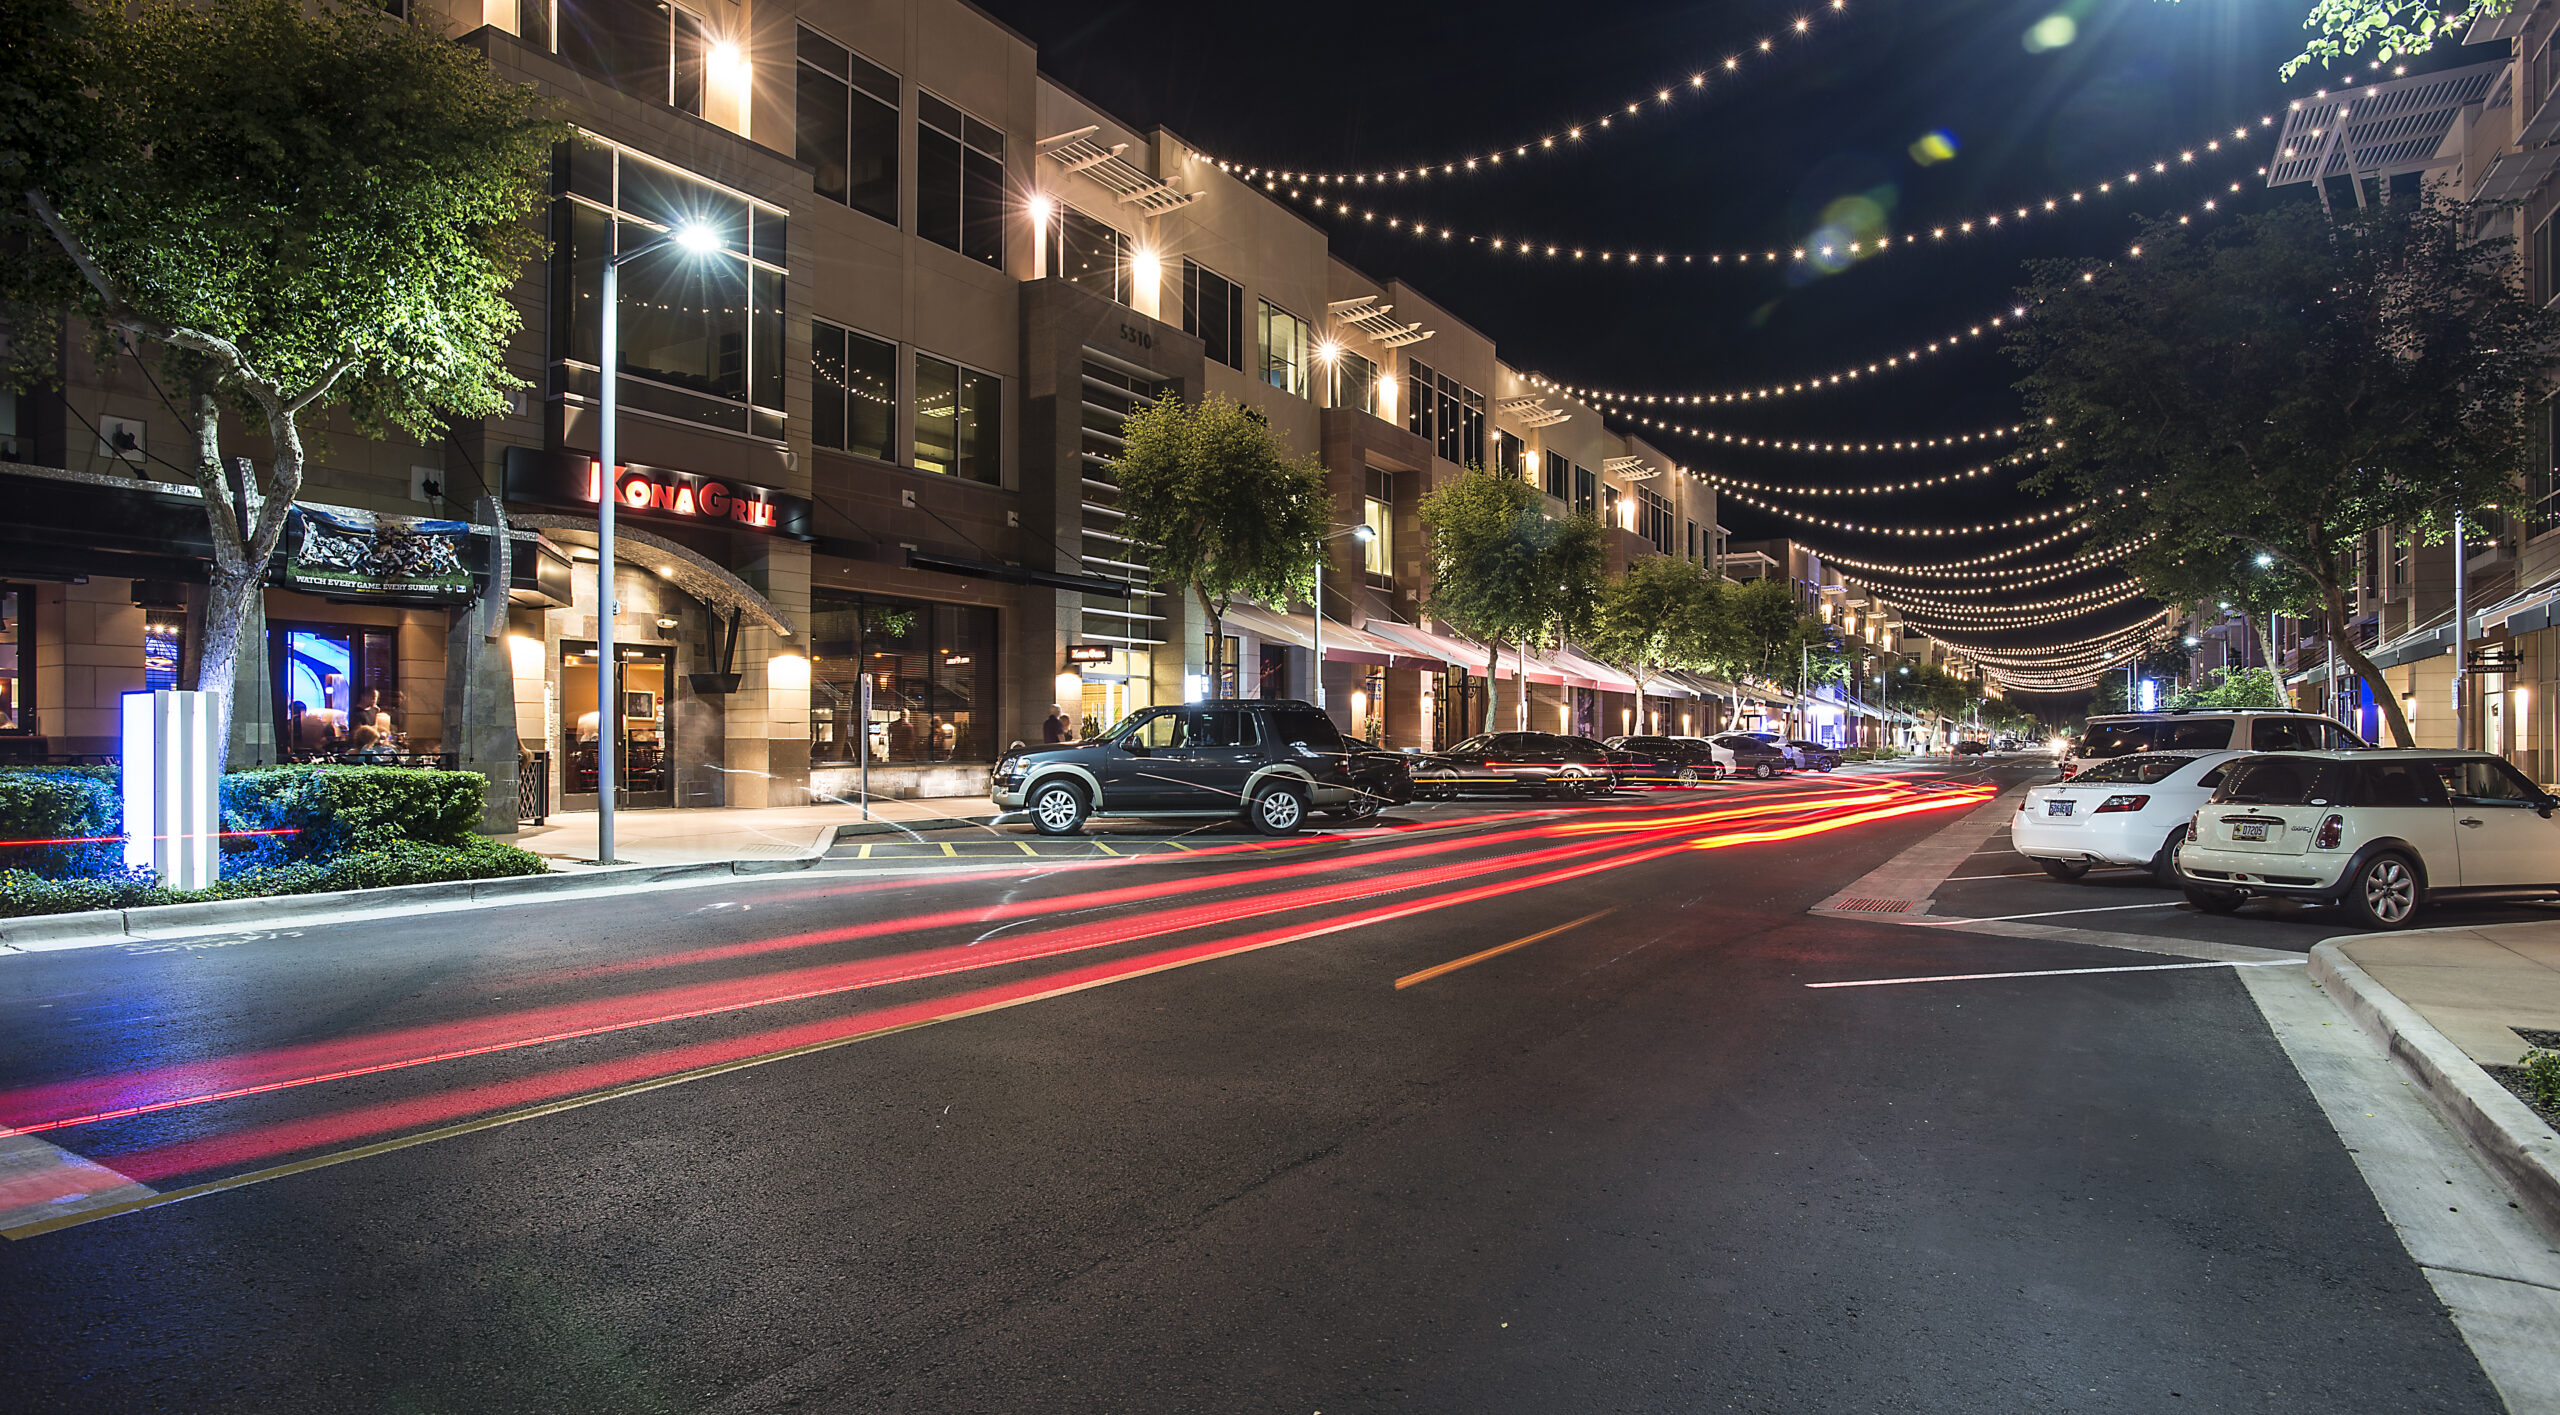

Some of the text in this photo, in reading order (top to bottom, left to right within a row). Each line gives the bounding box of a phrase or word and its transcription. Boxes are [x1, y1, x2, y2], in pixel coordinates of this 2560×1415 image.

[1120, 324, 1152, 350] 5310
[295, 575, 327, 586] WATCH
[328, 579, 356, 588] EVERY
[356, 581, 382, 590] GAME.
[383, 583, 407, 591] EVERY
[407, 584, 439, 592] SUNDAY.
